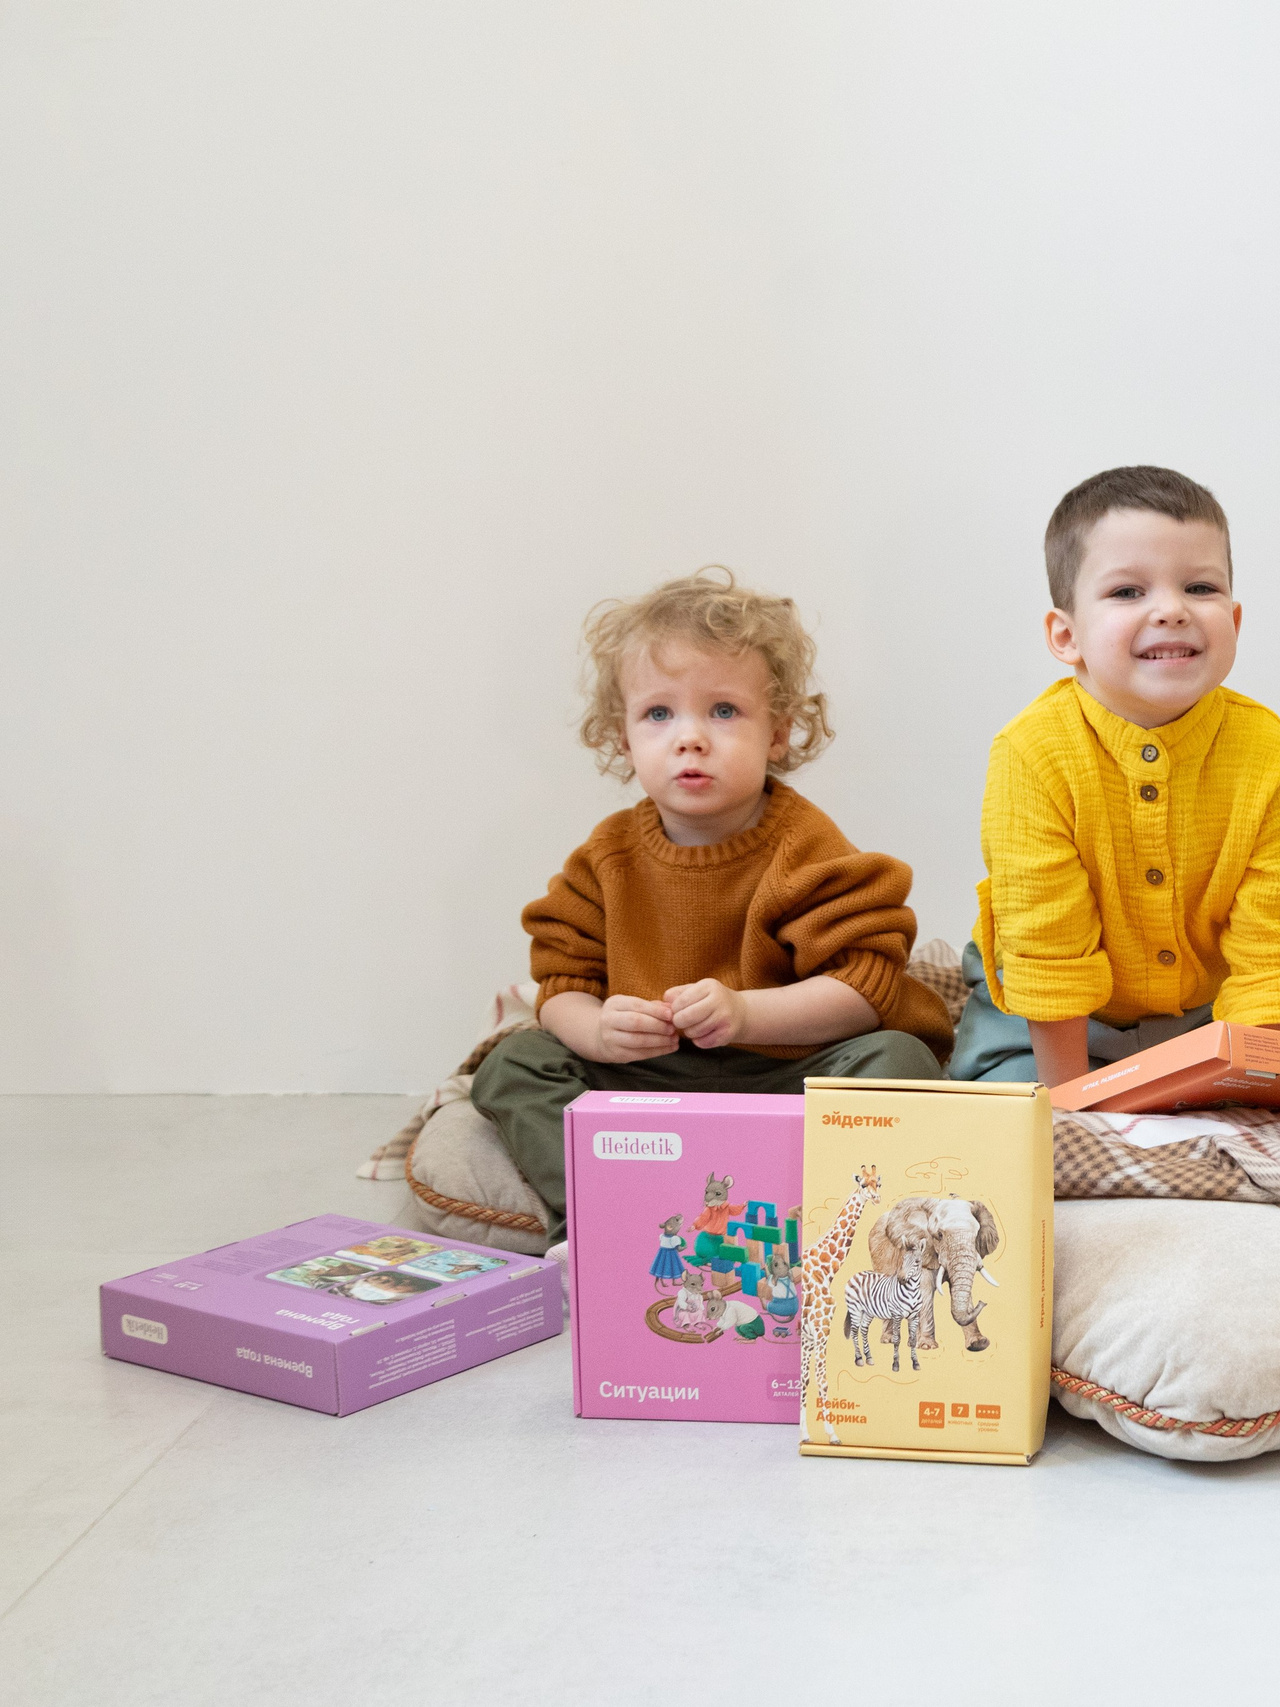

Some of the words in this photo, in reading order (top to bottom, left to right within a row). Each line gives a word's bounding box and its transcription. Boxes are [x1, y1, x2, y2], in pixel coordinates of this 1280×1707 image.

[601, 1136, 675, 1155] Heidetik
[236, 1347, 262, 1363] года
[264, 1354, 313, 1378] Времена
[599, 1381, 700, 1402] Ситуации
[816, 1411, 867, 1425] Африка
[957, 1406, 964, 1415] 7
